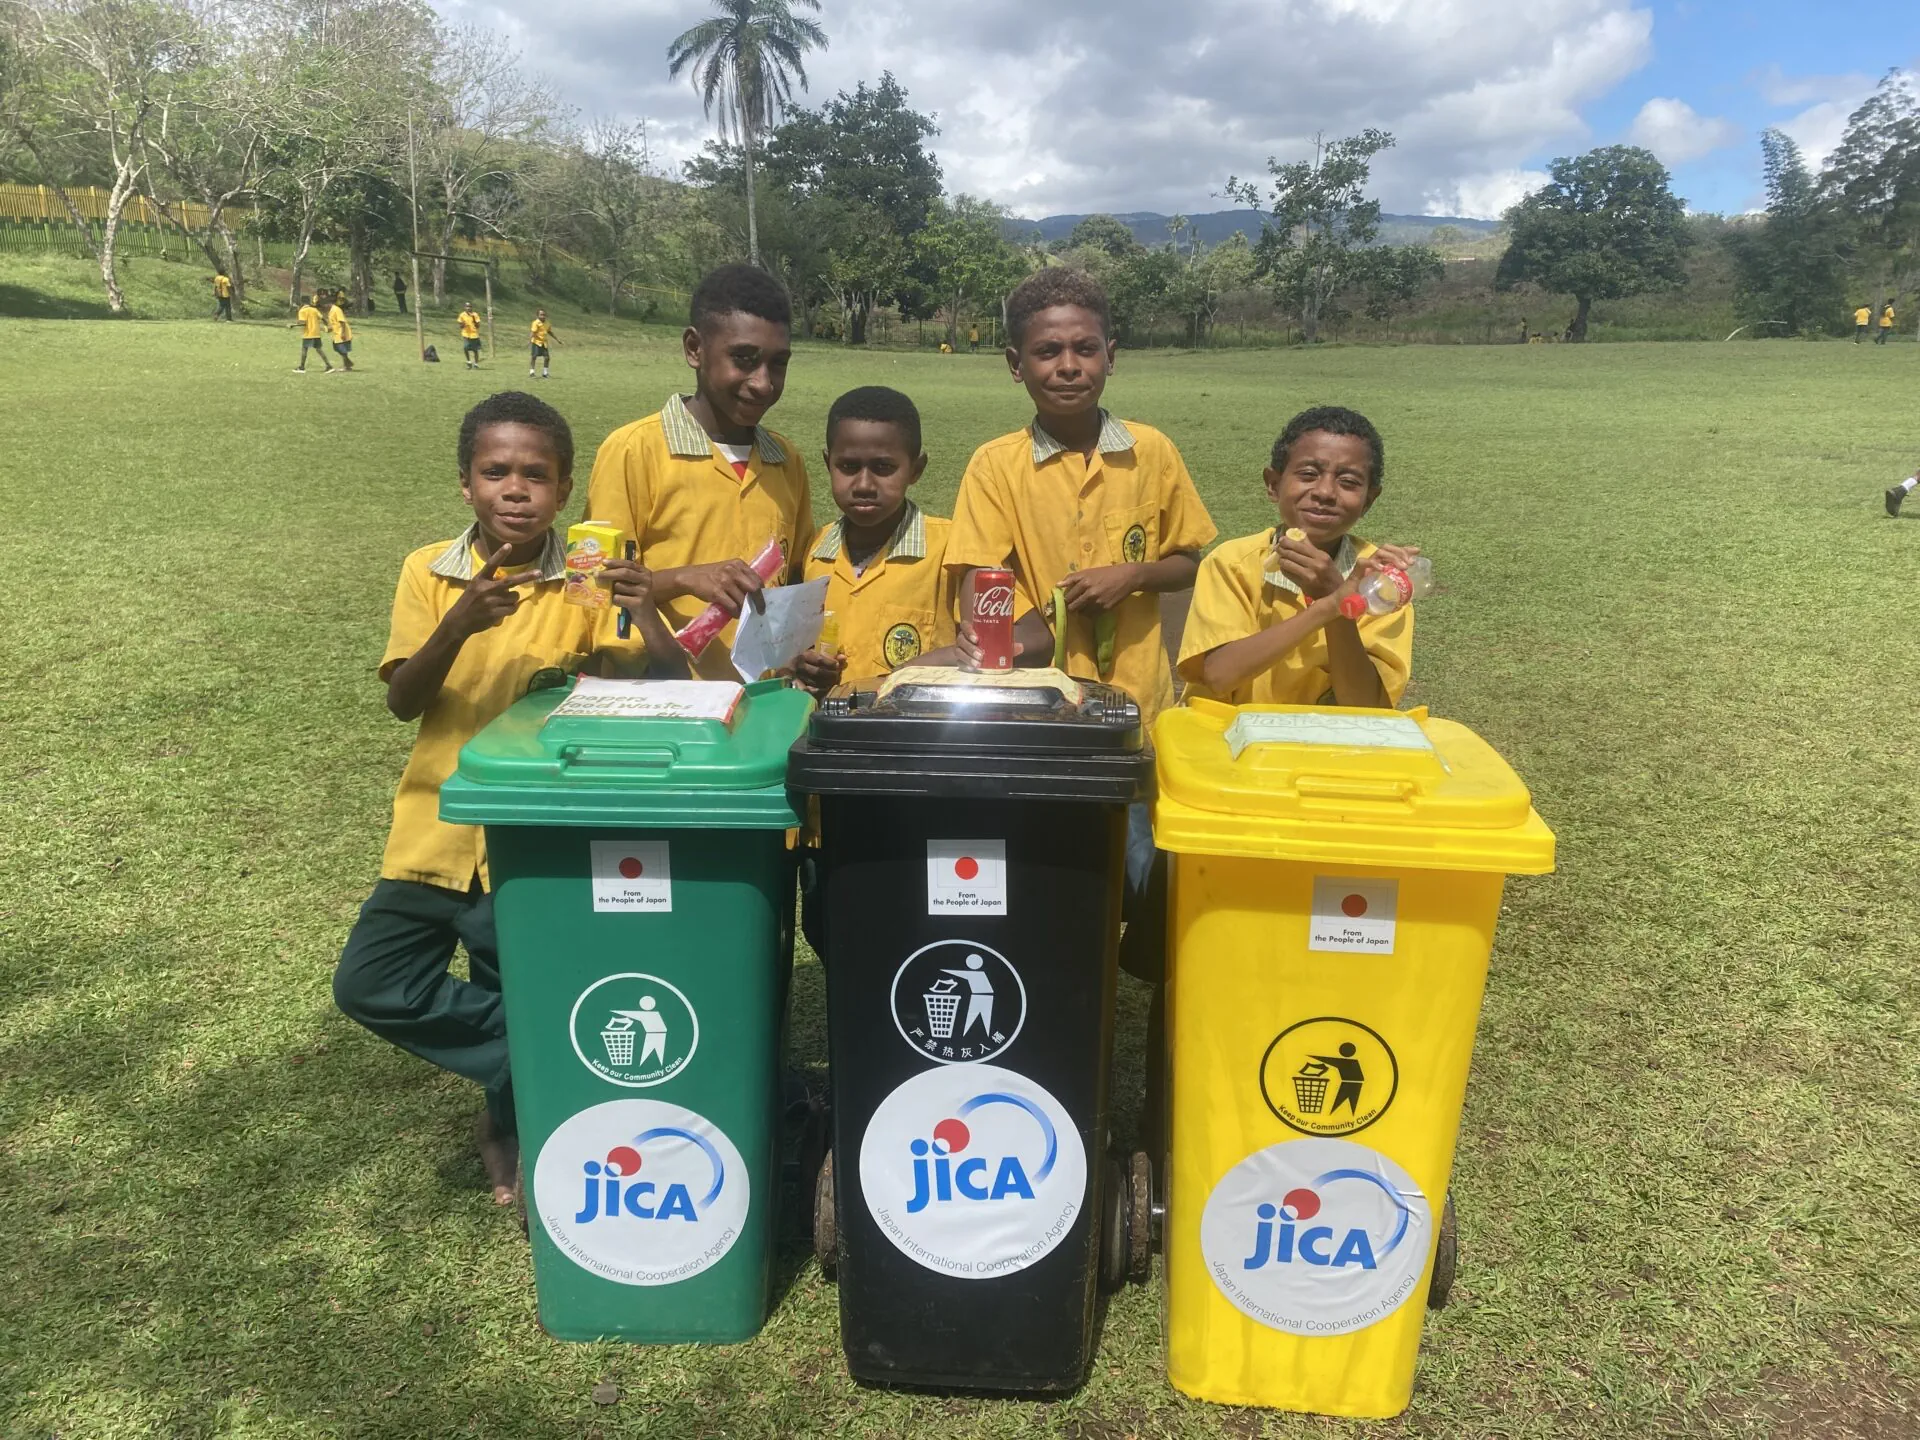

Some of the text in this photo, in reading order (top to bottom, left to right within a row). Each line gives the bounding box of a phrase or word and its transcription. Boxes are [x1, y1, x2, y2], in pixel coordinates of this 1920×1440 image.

[611, 896, 635, 905] People
[645, 896, 667, 905] Japan
[933, 898, 1002, 907] the People of Japan
[1329, 936, 1354, 944] People
[1366, 938, 1389, 946] Japan
[592, 1057, 683, 1080] Keep our Community Clean
[1278, 1104, 1377, 1131] Keep our Community Clean
[547, 1216, 736, 1282] Japan International Cooperation Agency
[877, 1202, 1076, 1273] Japan International Cooperation Agency
[1213, 1260, 1416, 1332] Japan International Cooperation Agency
